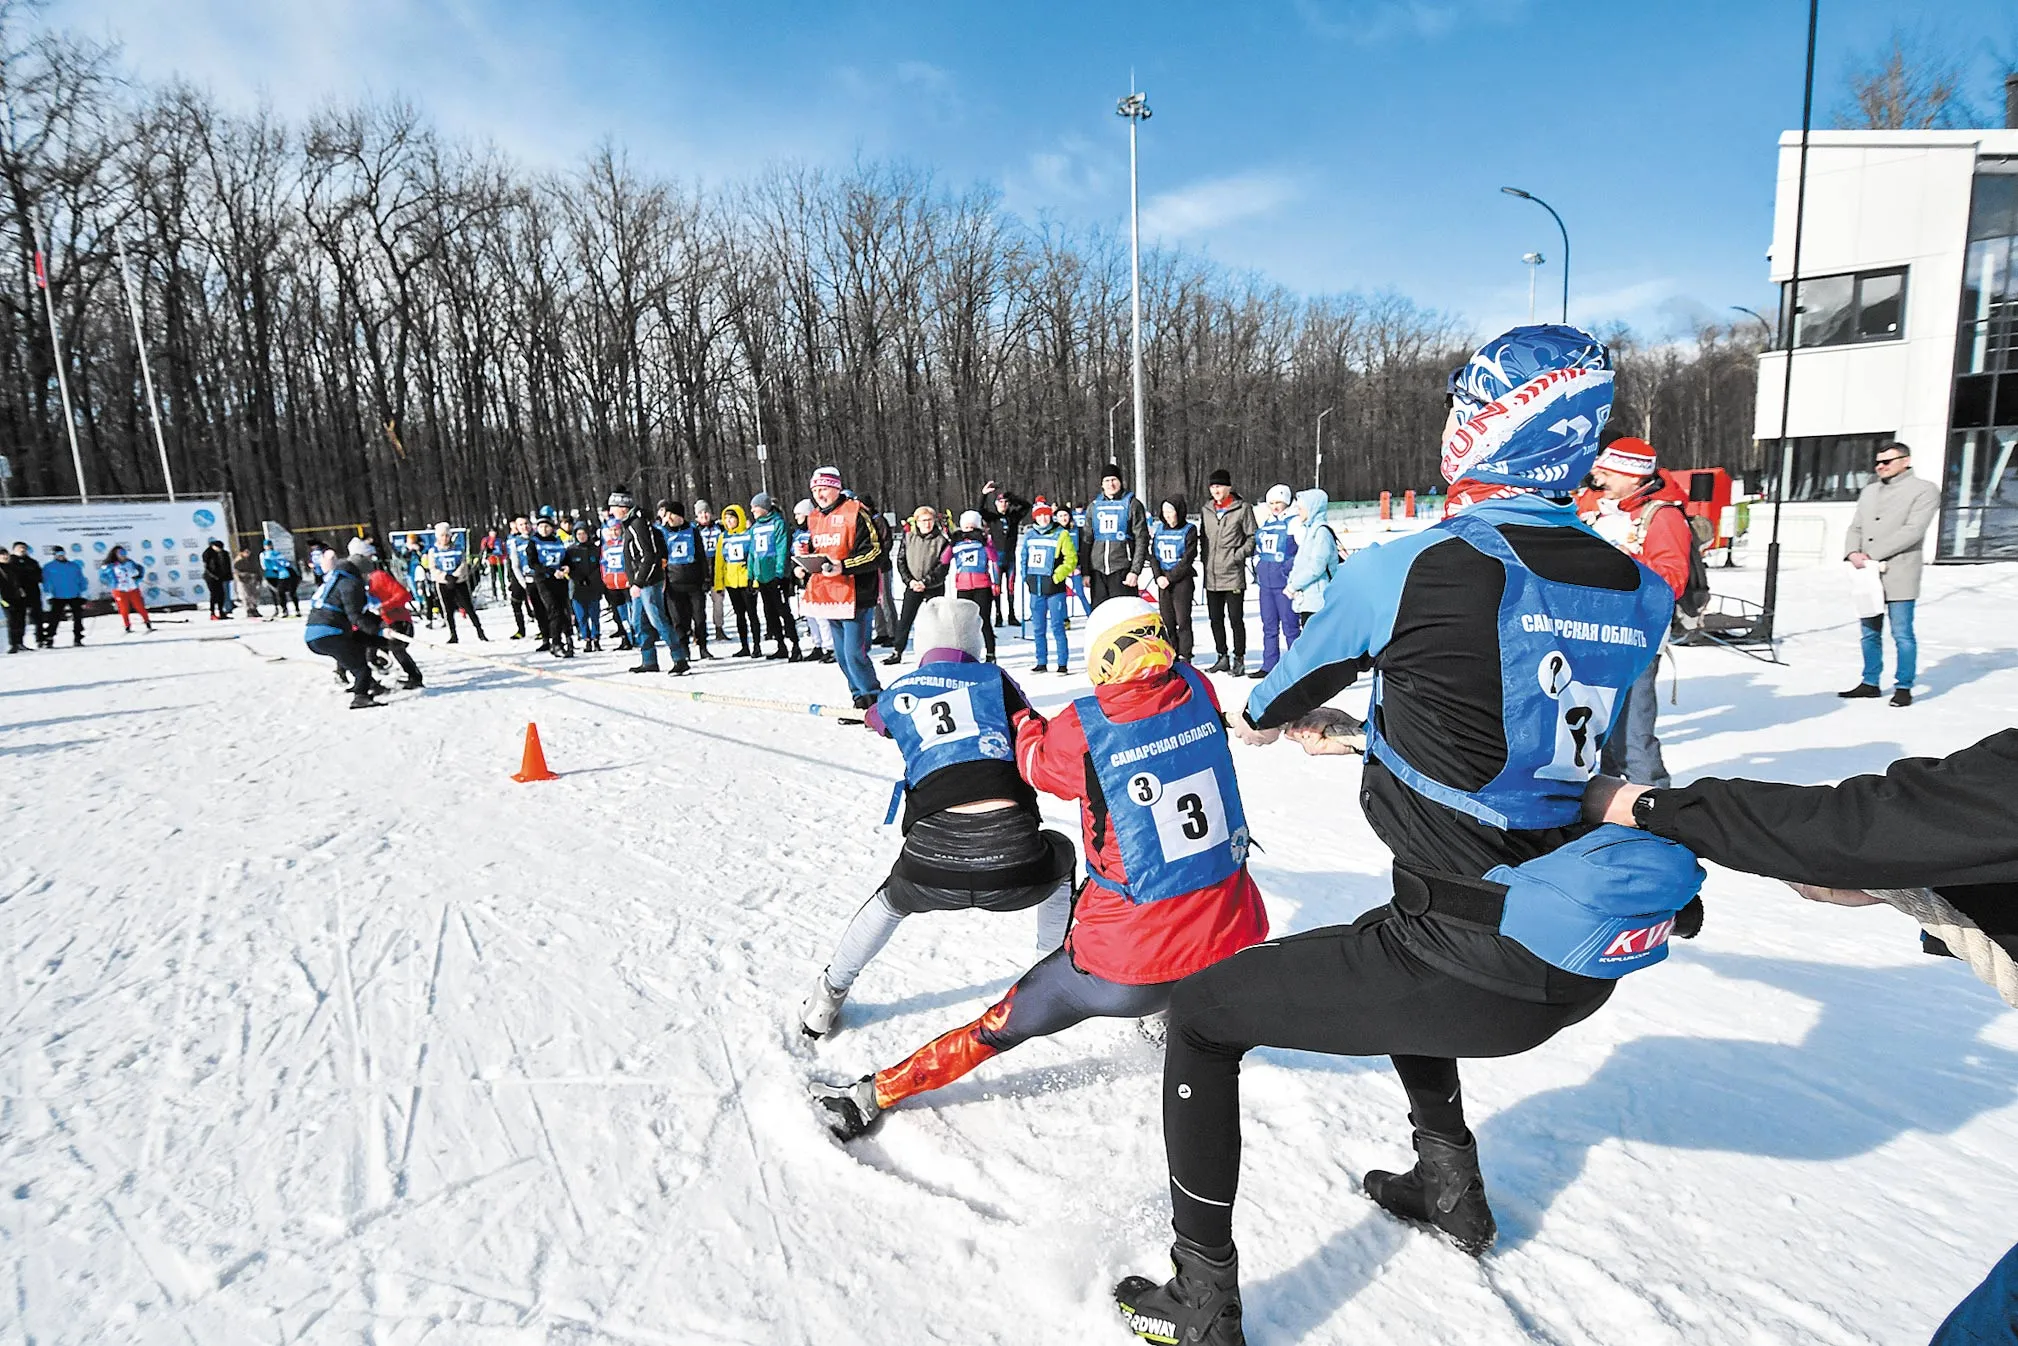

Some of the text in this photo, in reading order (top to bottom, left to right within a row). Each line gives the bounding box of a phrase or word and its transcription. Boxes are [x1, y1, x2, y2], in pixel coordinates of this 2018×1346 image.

[1104, 519, 1114, 529] 11
[1163, 549, 1173, 560] 11
[1265, 539, 1274, 550] 11
[1601, 625, 1647, 648] ОБЛАСТЬ
[930, 701, 957, 735] 3
[1110, 721, 1217, 768] САМАРСКАЯ ОБЛАСТЬ
[1134, 776, 1154, 802] 3
[1176, 792, 1209, 840] 3
